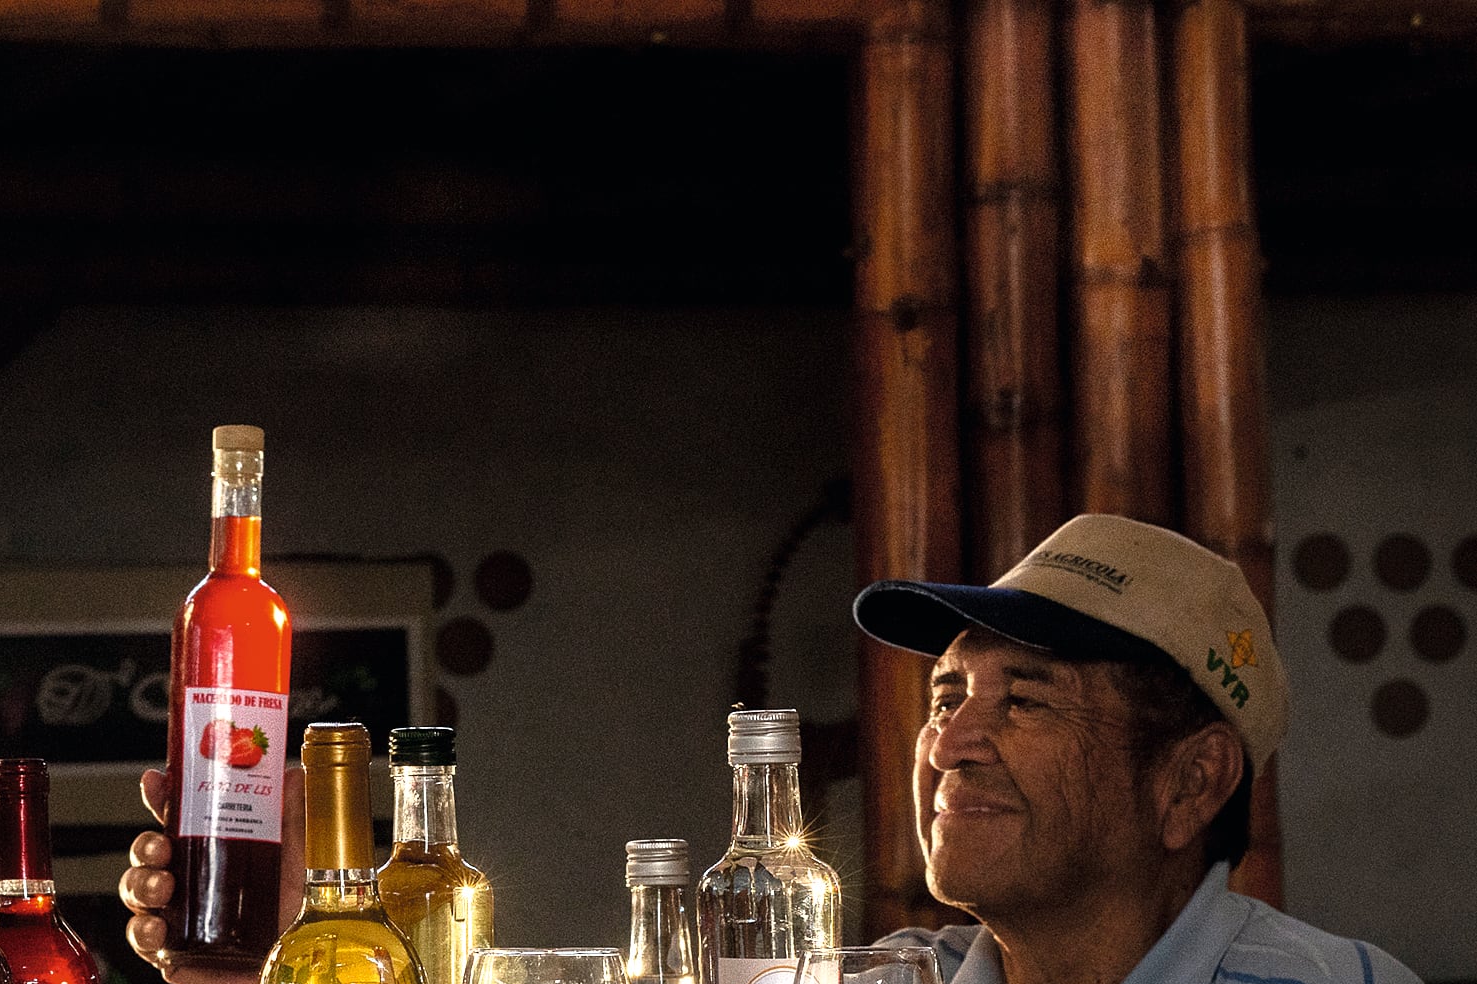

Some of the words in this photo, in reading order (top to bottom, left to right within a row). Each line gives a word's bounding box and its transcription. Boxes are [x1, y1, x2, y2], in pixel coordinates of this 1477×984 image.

[1207, 647, 1250, 709] VYR
[244, 696, 257, 707] DE
[258, 696, 282, 709] FRESA
[235, 783, 252, 793] DE
[254, 785, 272, 796] LIS
